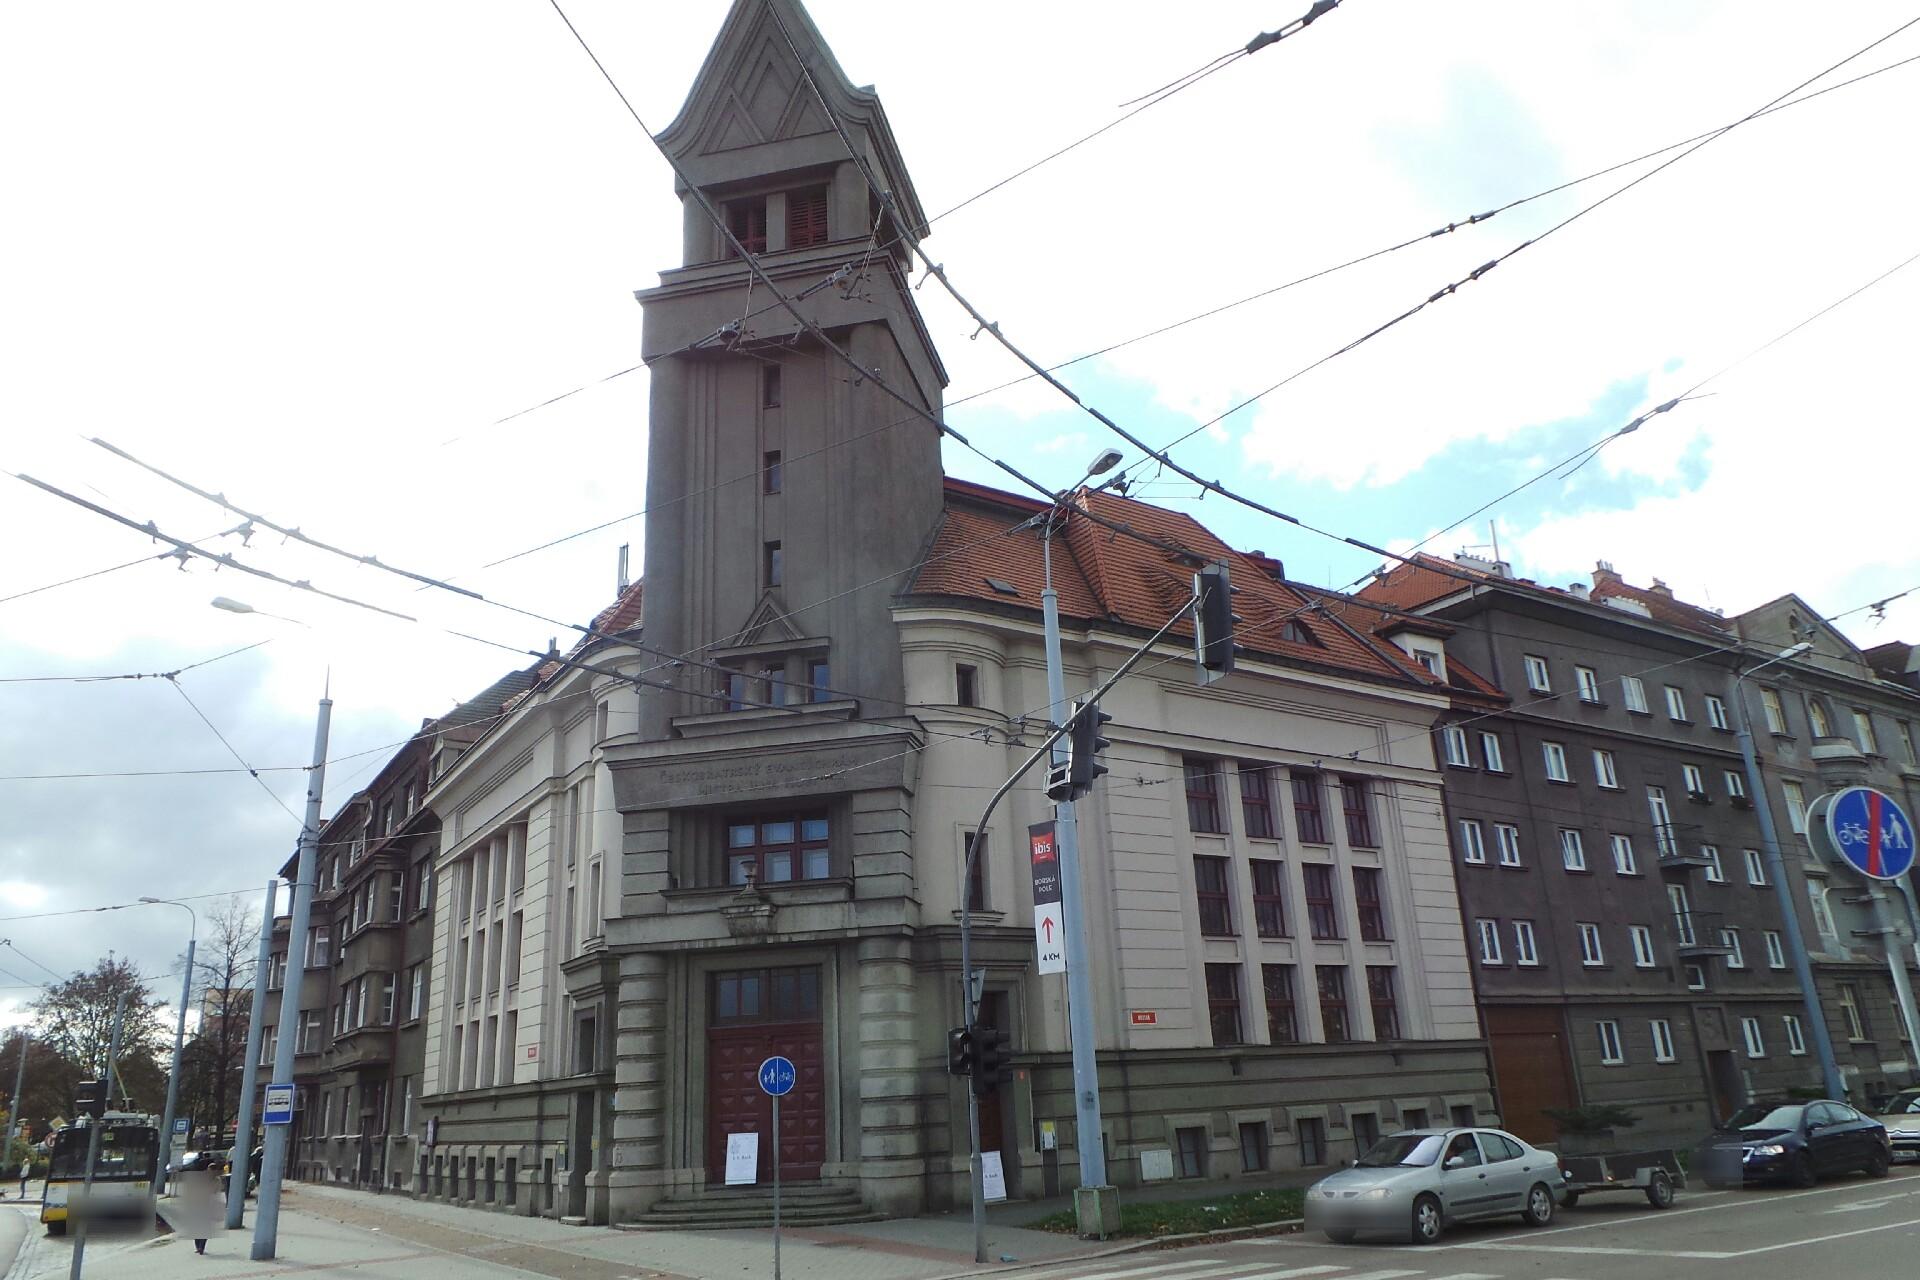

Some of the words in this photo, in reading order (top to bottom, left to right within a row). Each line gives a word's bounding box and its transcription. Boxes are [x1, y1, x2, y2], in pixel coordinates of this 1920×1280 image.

[1034, 842, 1051, 855] ibis
[1038, 884, 1053, 893] POLE
[1042, 953, 1048, 961] 4
[1049, 952, 1060, 961] KM
